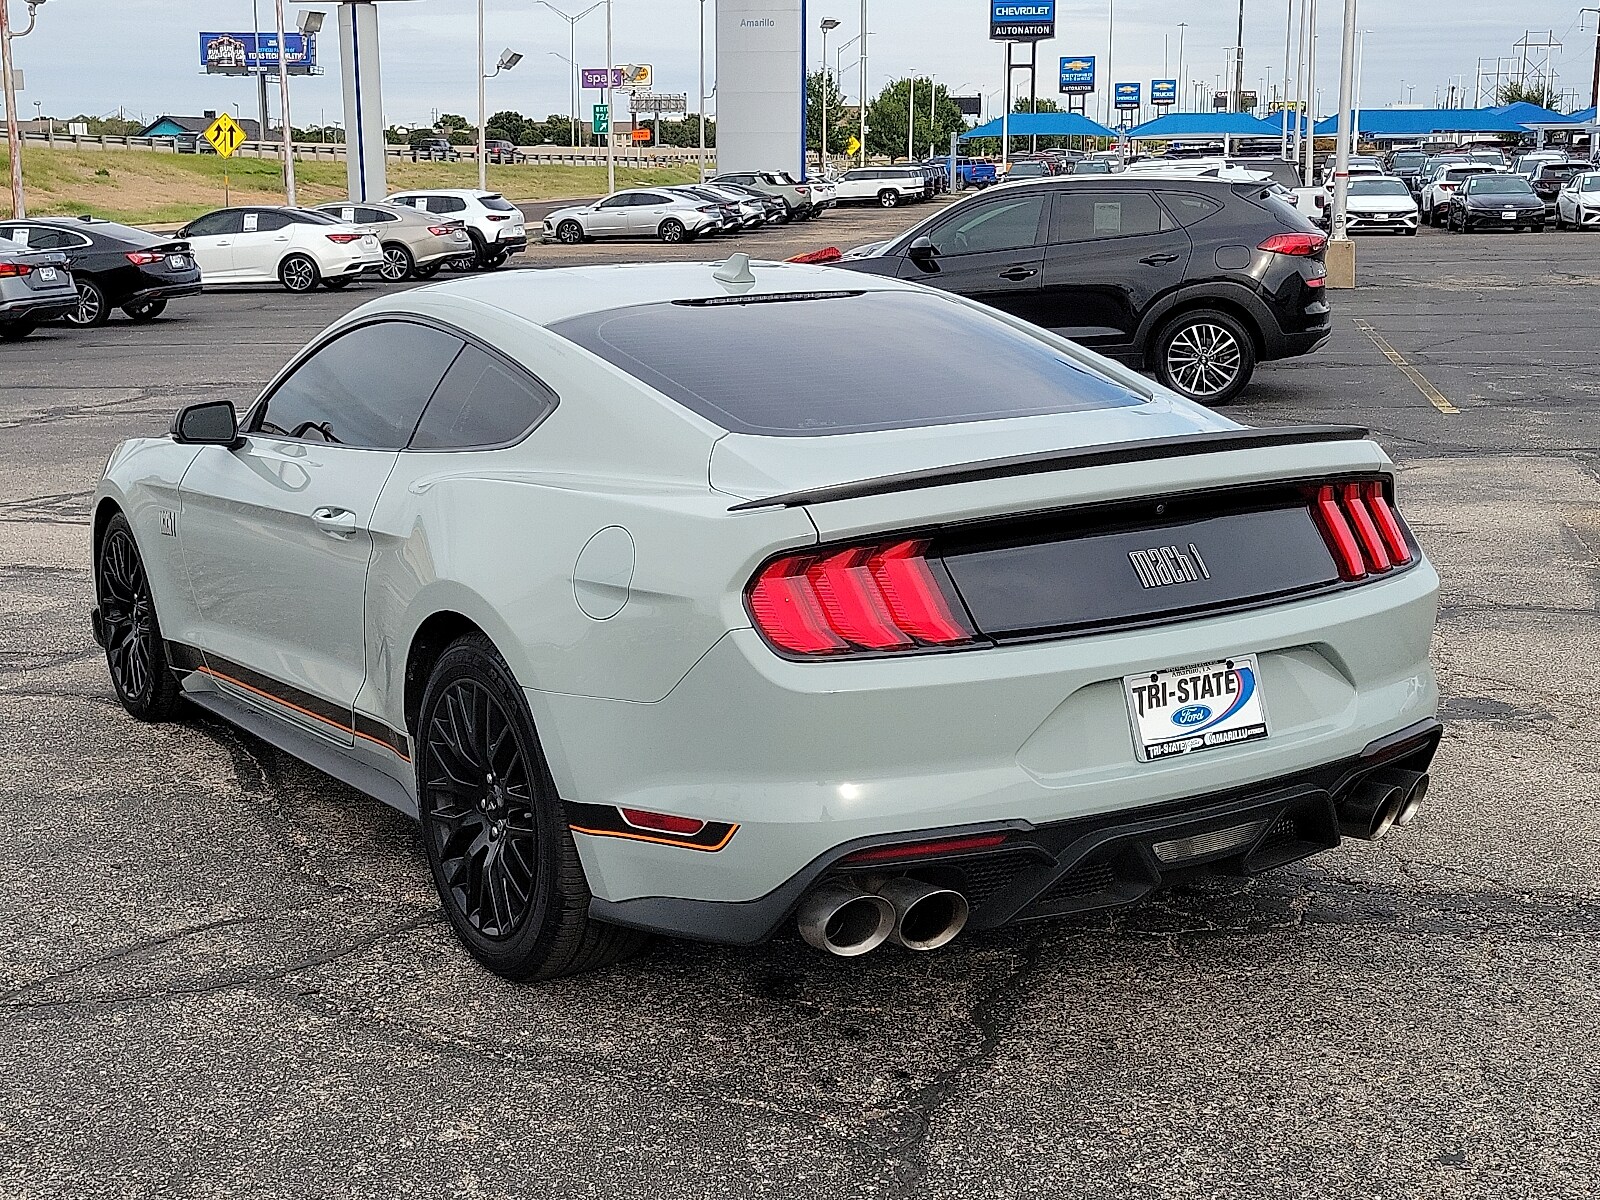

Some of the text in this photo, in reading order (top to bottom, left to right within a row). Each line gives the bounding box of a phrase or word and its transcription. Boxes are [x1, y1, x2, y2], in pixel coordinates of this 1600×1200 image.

[996, 6, 1050, 16] CHEVROLET
[740, 18, 775, 28] Amarillo
[995, 26, 1050, 35] AUTONATION
[587, 71, 618, 86] spak
[1132, 671, 1236, 719] TRI-STATE
[1179, 707, 1205, 723] Ford
[1147, 741, 1186, 759] TRI-STATE
